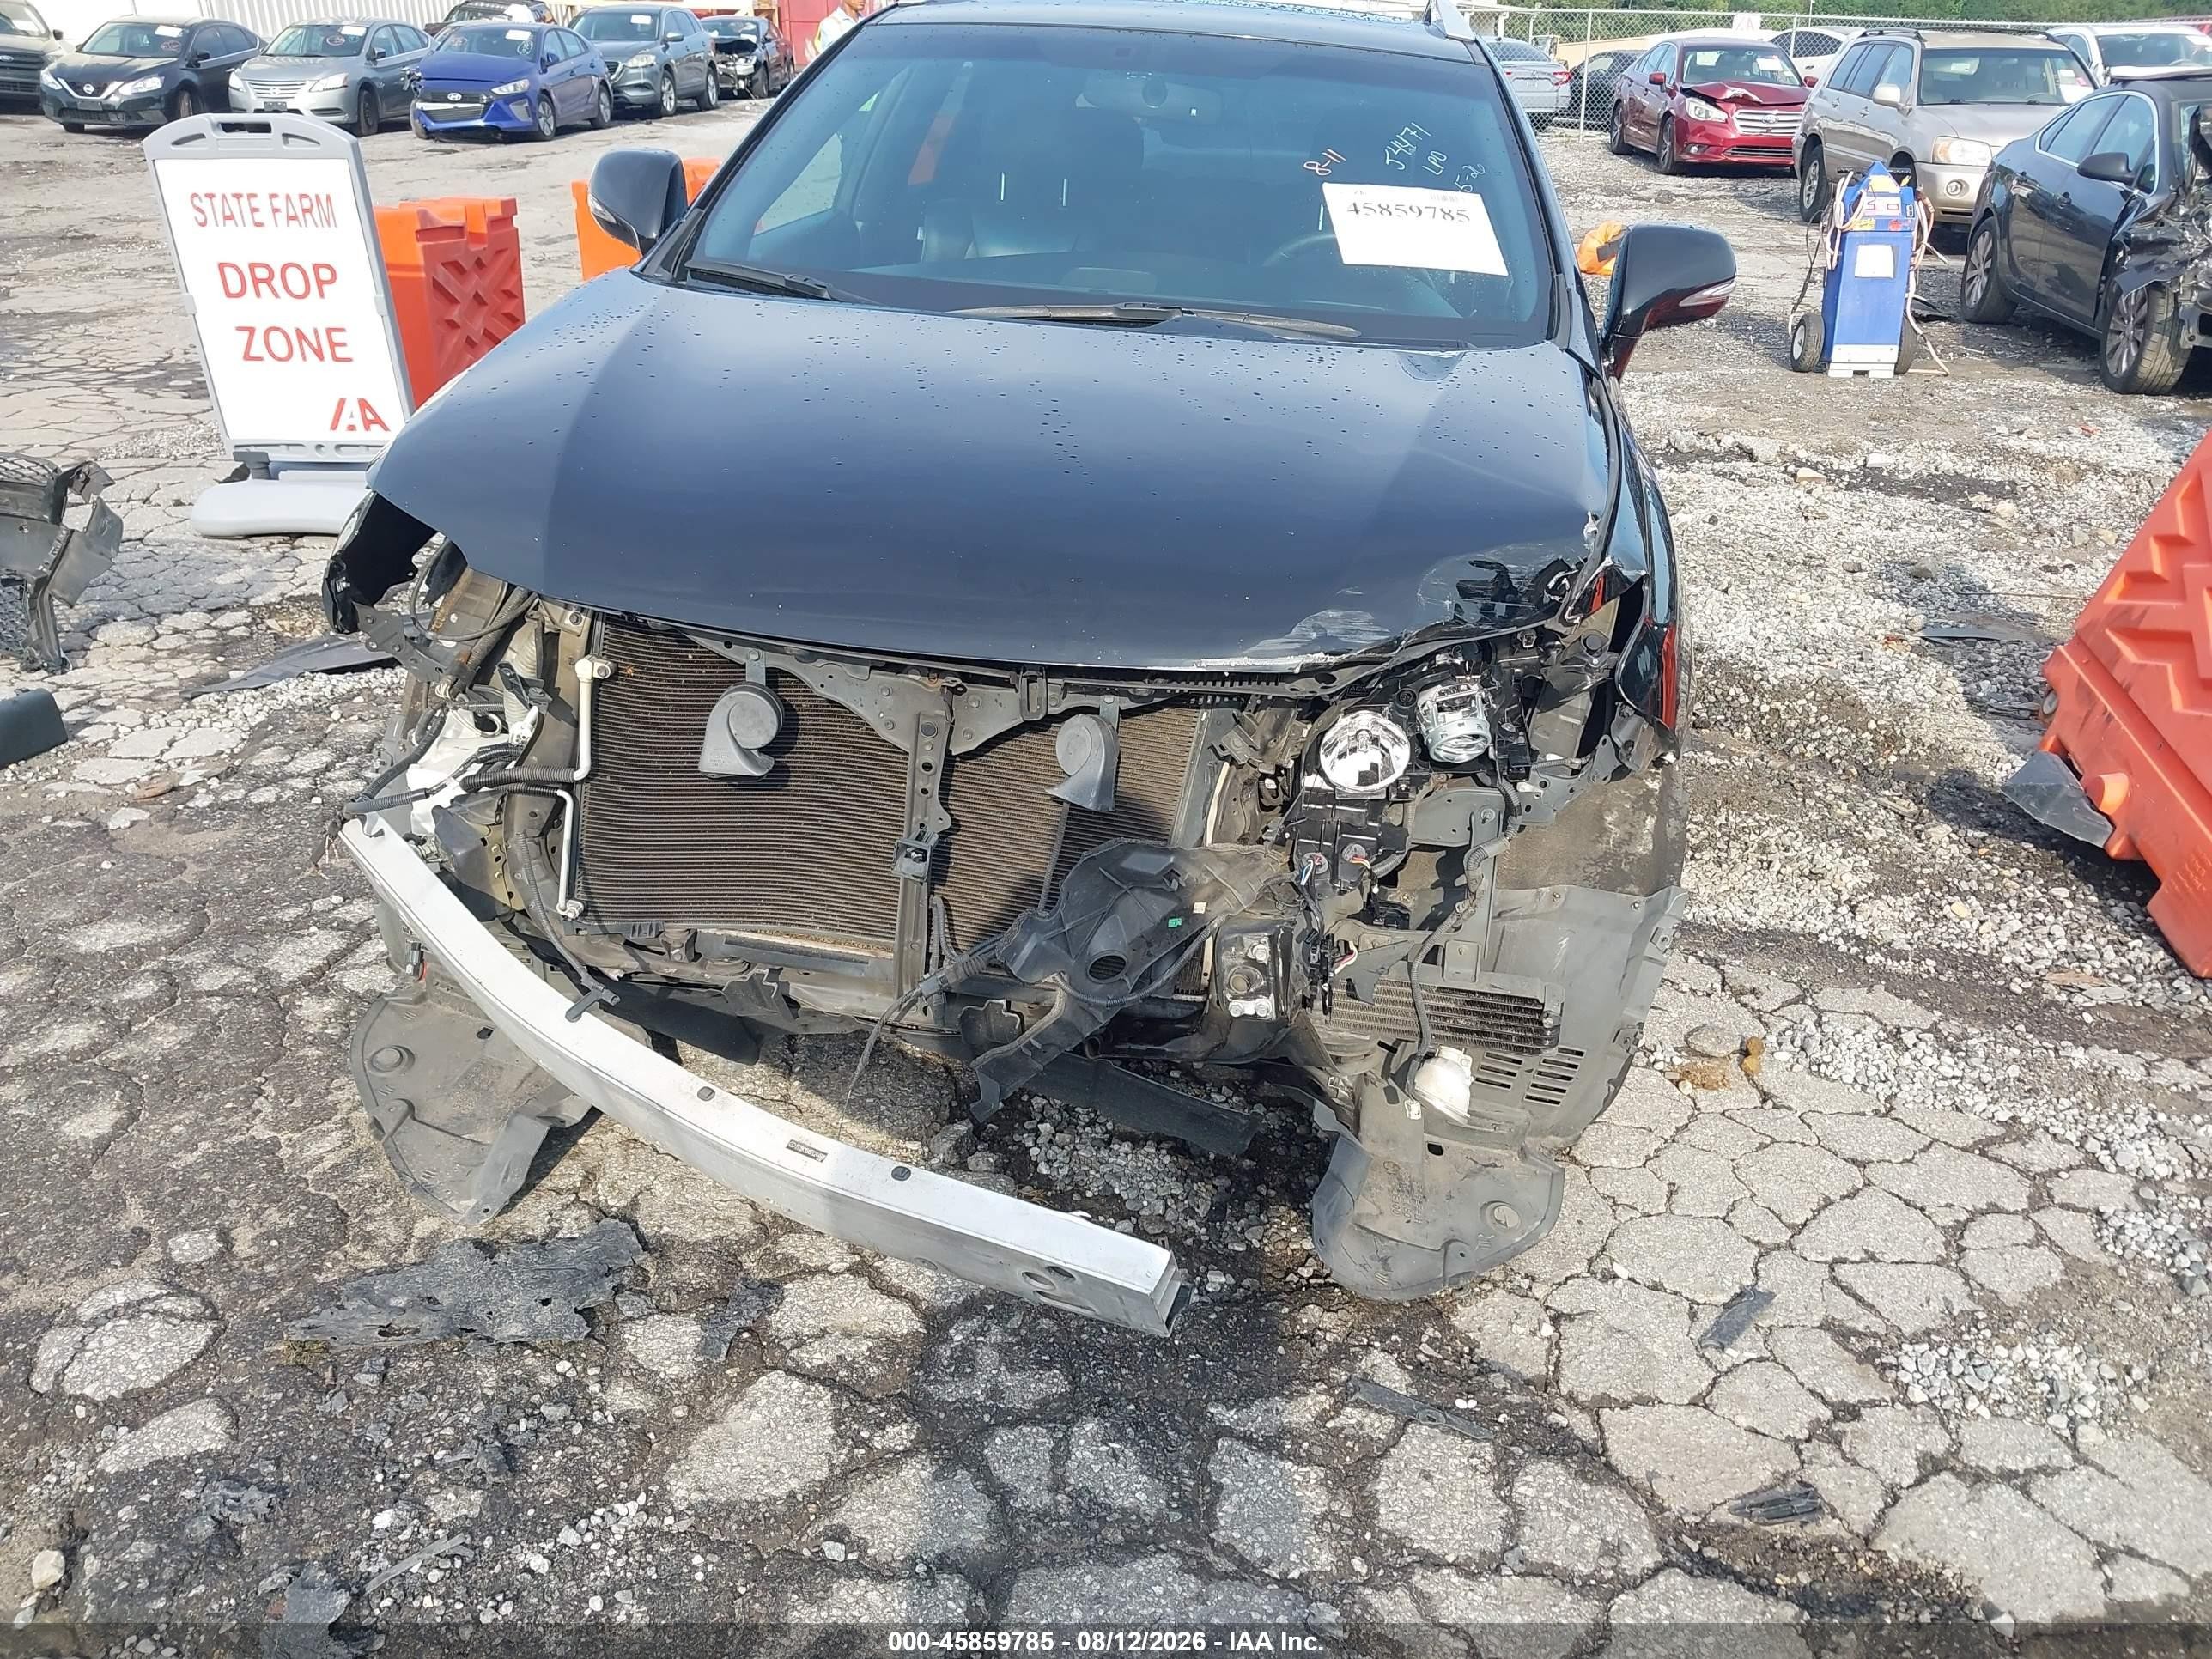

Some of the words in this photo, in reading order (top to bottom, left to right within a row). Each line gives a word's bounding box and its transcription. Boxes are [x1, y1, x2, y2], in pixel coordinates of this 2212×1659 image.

[1304, 149, 1346, 175] 8-11
[190, 192, 265, 228] STATE
[268, 192, 337, 228] FARM
[1346, 202, 1470, 222] 45859785
[216, 262, 337, 300] DROP
[234, 325, 354, 362] ZONE
